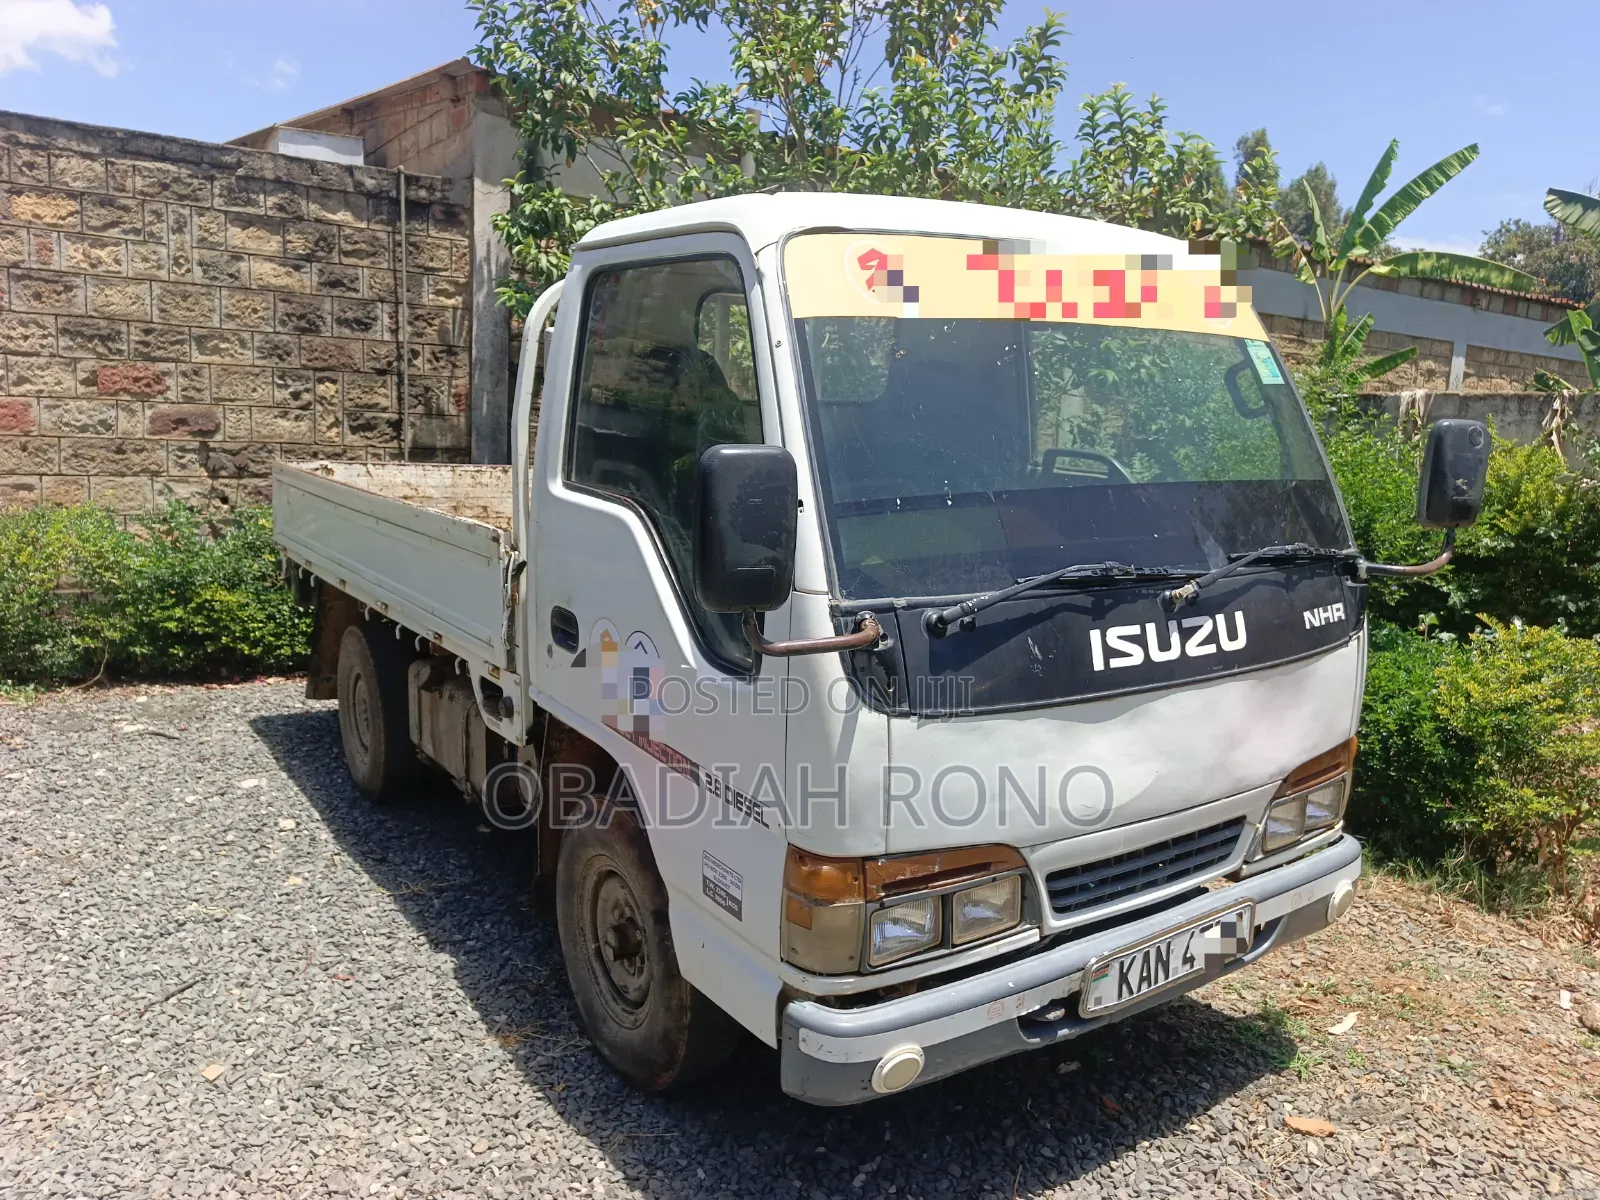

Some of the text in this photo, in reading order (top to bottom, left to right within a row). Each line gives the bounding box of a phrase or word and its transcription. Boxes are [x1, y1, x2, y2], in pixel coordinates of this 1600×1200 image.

[1089, 610, 1247, 672] ISUZU
[1303, 602, 1346, 630] NHR
[704, 772, 770, 829] 2.8 DIESEL
[1117, 938, 1172, 1000] KAN
